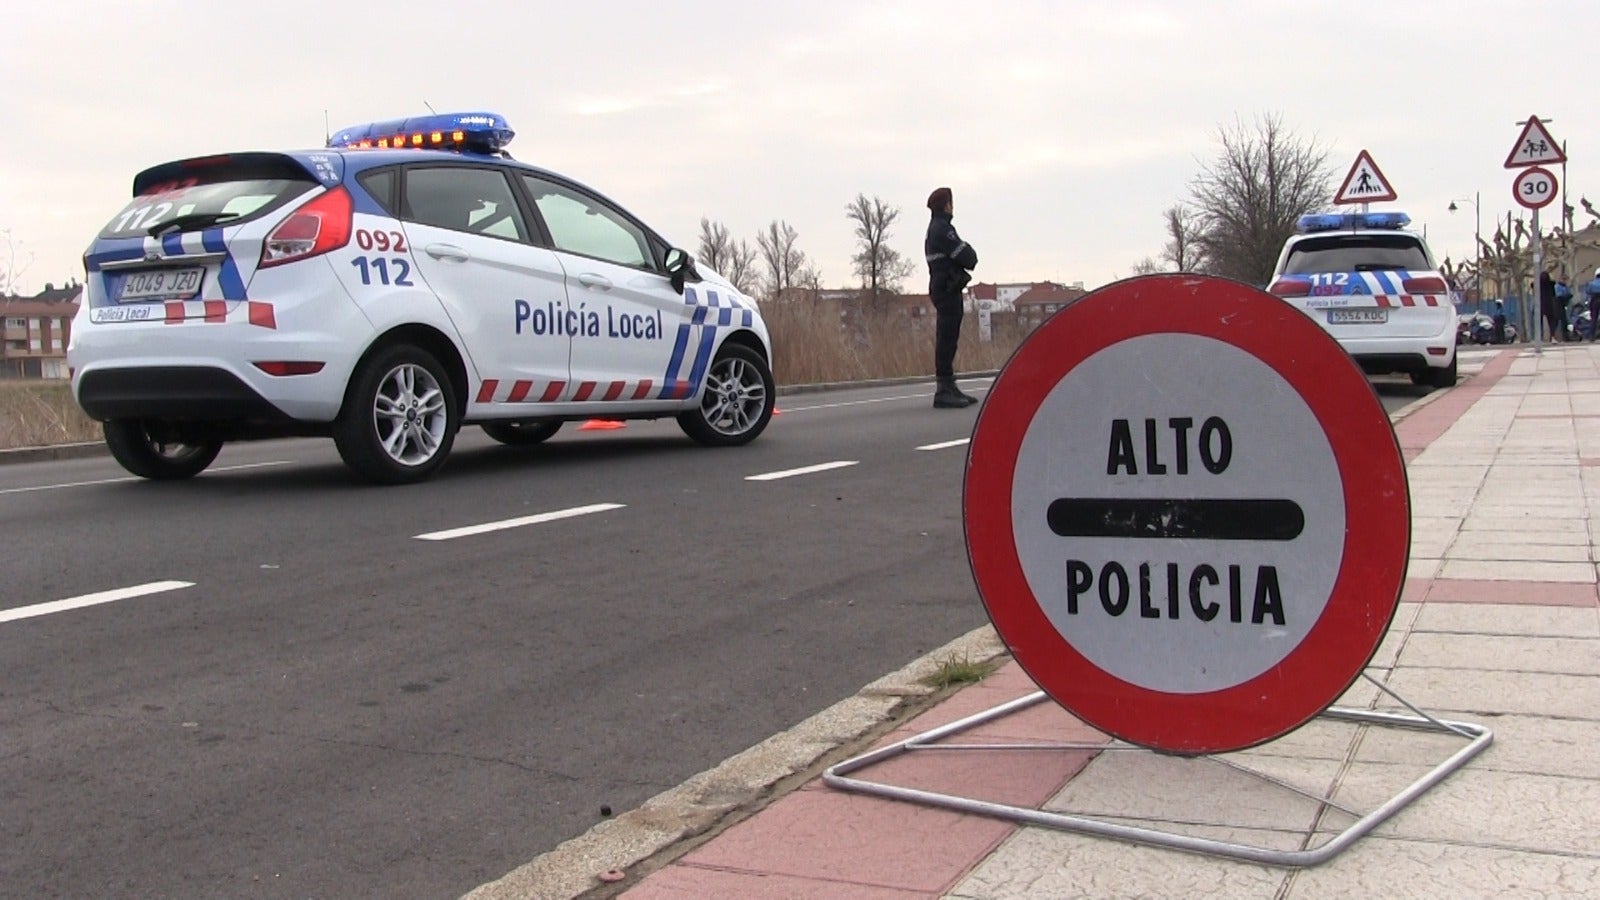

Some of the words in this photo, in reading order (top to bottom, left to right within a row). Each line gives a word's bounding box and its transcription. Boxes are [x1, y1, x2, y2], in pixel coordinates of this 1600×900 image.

[1523, 180, 1548, 195] 30
[113, 202, 173, 233] 112
[356, 229, 407, 253] 092
[351, 256, 414, 287] 112
[1308, 272, 1349, 286] 112
[126, 306, 151, 320] Local
[514, 299, 599, 337] Policía
[607, 305, 662, 340] Local
[1107, 416, 1232, 475] ALTO
[1066, 560, 1286, 626] POLICIA
